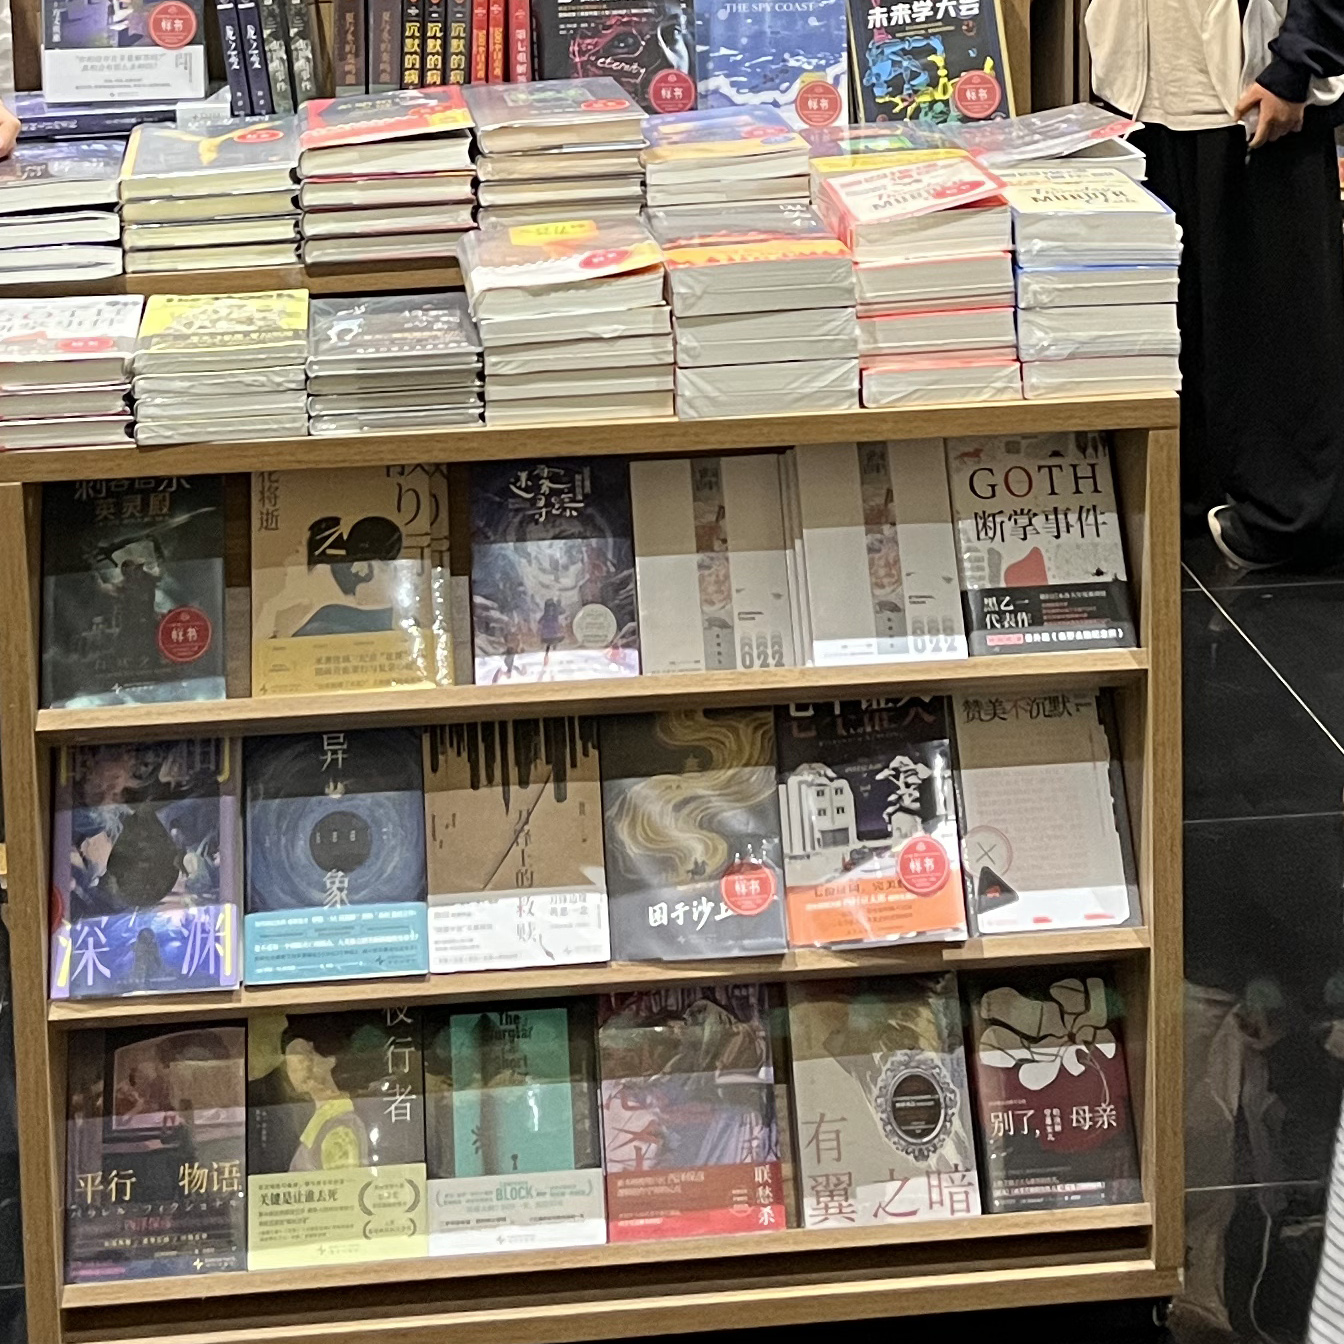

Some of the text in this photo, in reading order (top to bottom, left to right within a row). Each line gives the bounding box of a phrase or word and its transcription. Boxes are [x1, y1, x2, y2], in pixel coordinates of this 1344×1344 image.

[725, 2, 815, 12] THE SPY COAST
[596, 56, 646, 83] eternity
[969, 462, 1102, 500] GOTH
[974, 505, 1108, 543] 断掌事件
[1070, 1103, 1117, 1130] 母亲
[801, 1113, 848, 1164] 有
[74, 1159, 243, 1204] 平行 物语
[496, 1185, 534, 1202] BLOCK
